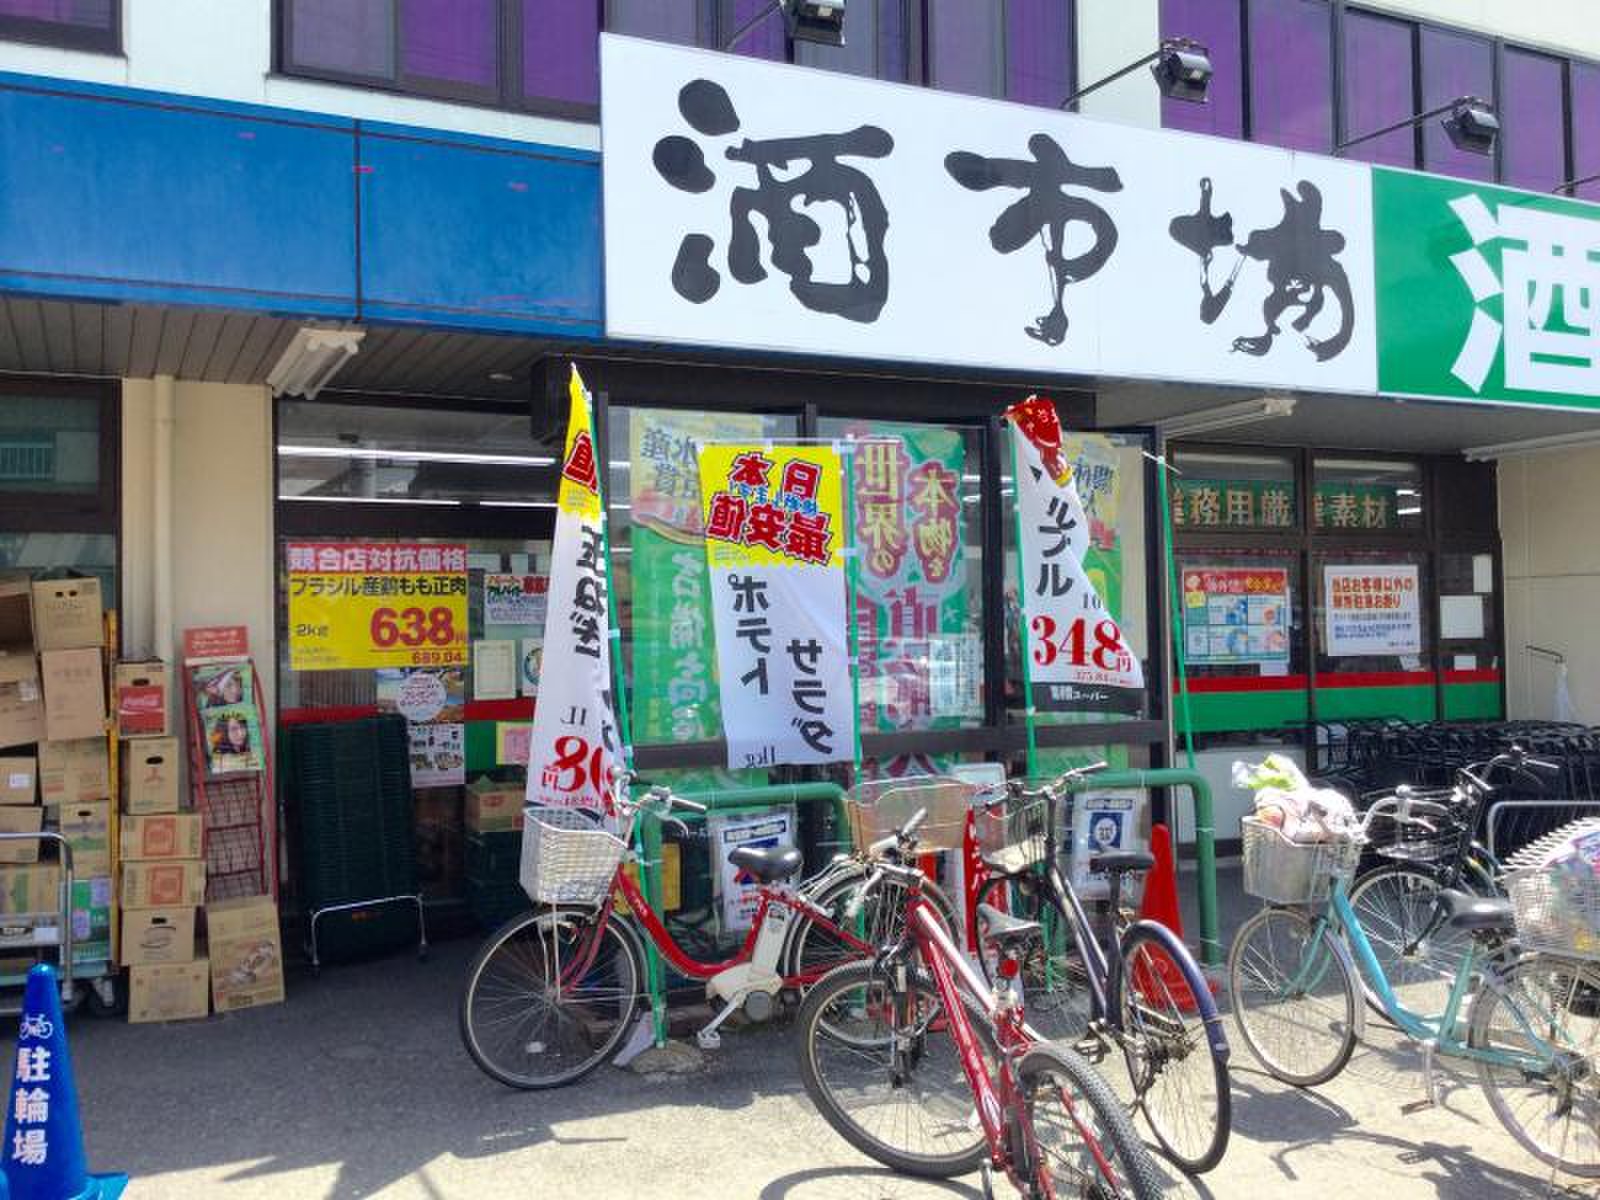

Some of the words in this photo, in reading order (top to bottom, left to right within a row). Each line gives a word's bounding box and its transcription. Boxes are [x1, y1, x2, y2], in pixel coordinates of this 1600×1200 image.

[652, 78, 1355, 362] 酒市場
[1447, 192, 1600, 394] 酒
[288, 546, 466, 571] 競合店対抗価格
[12, 1046, 51, 1166] 駐輪場
